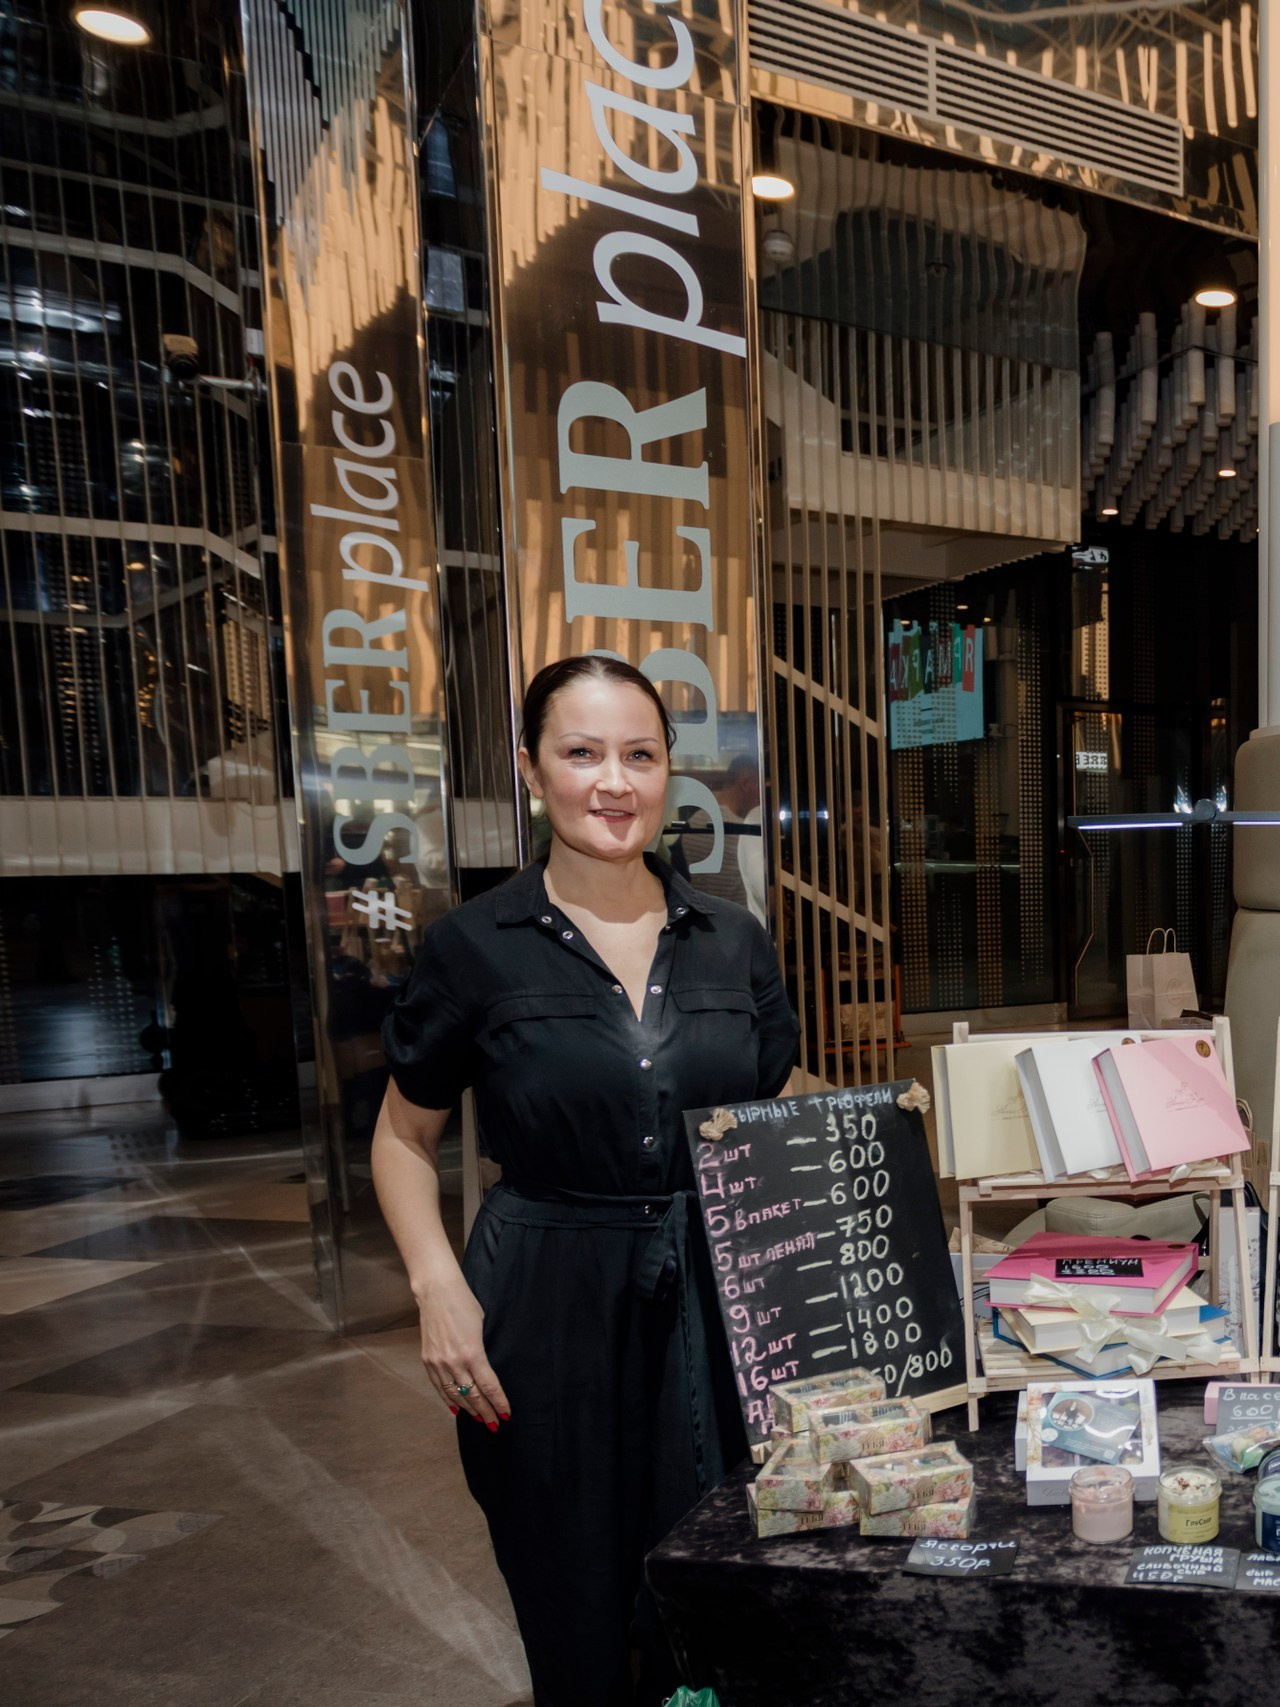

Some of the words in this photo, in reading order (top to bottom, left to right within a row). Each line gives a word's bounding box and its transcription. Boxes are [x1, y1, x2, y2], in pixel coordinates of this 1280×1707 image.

[540, 0, 747, 358] plac
[309, 361, 429, 592] place
[696, 1143, 723, 1170] 2
[825, 1112, 877, 1142] 350
[700, 1171, 724, 1199] 4
[828, 1141, 885, 1174] 600
[706, 1204, 731, 1238] 5
[830, 1169, 890, 1205] 600
[715, 1241, 733, 1272] 5
[836, 1204, 894, 1239] 750
[723, 1275, 740, 1299] 6
[839, 1234, 890, 1266] 800
[729, 1303, 751, 1332] 9
[839, 1261, 904, 1299] 1200
[730, 1336, 768, 1367] 12
[844, 1295, 914, 1333] 1400
[736, 1364, 769, 1397] 16
[849, 1321, 922, 1359] 1800
[1222, 1388, 1236, 1401] В
[1232, 1404, 1274, 1417] 600
[1137, 1563, 1223, 1572] СЛИВОЧНЫЙ
[1169, 1554, 1223, 1564] ГРУША
